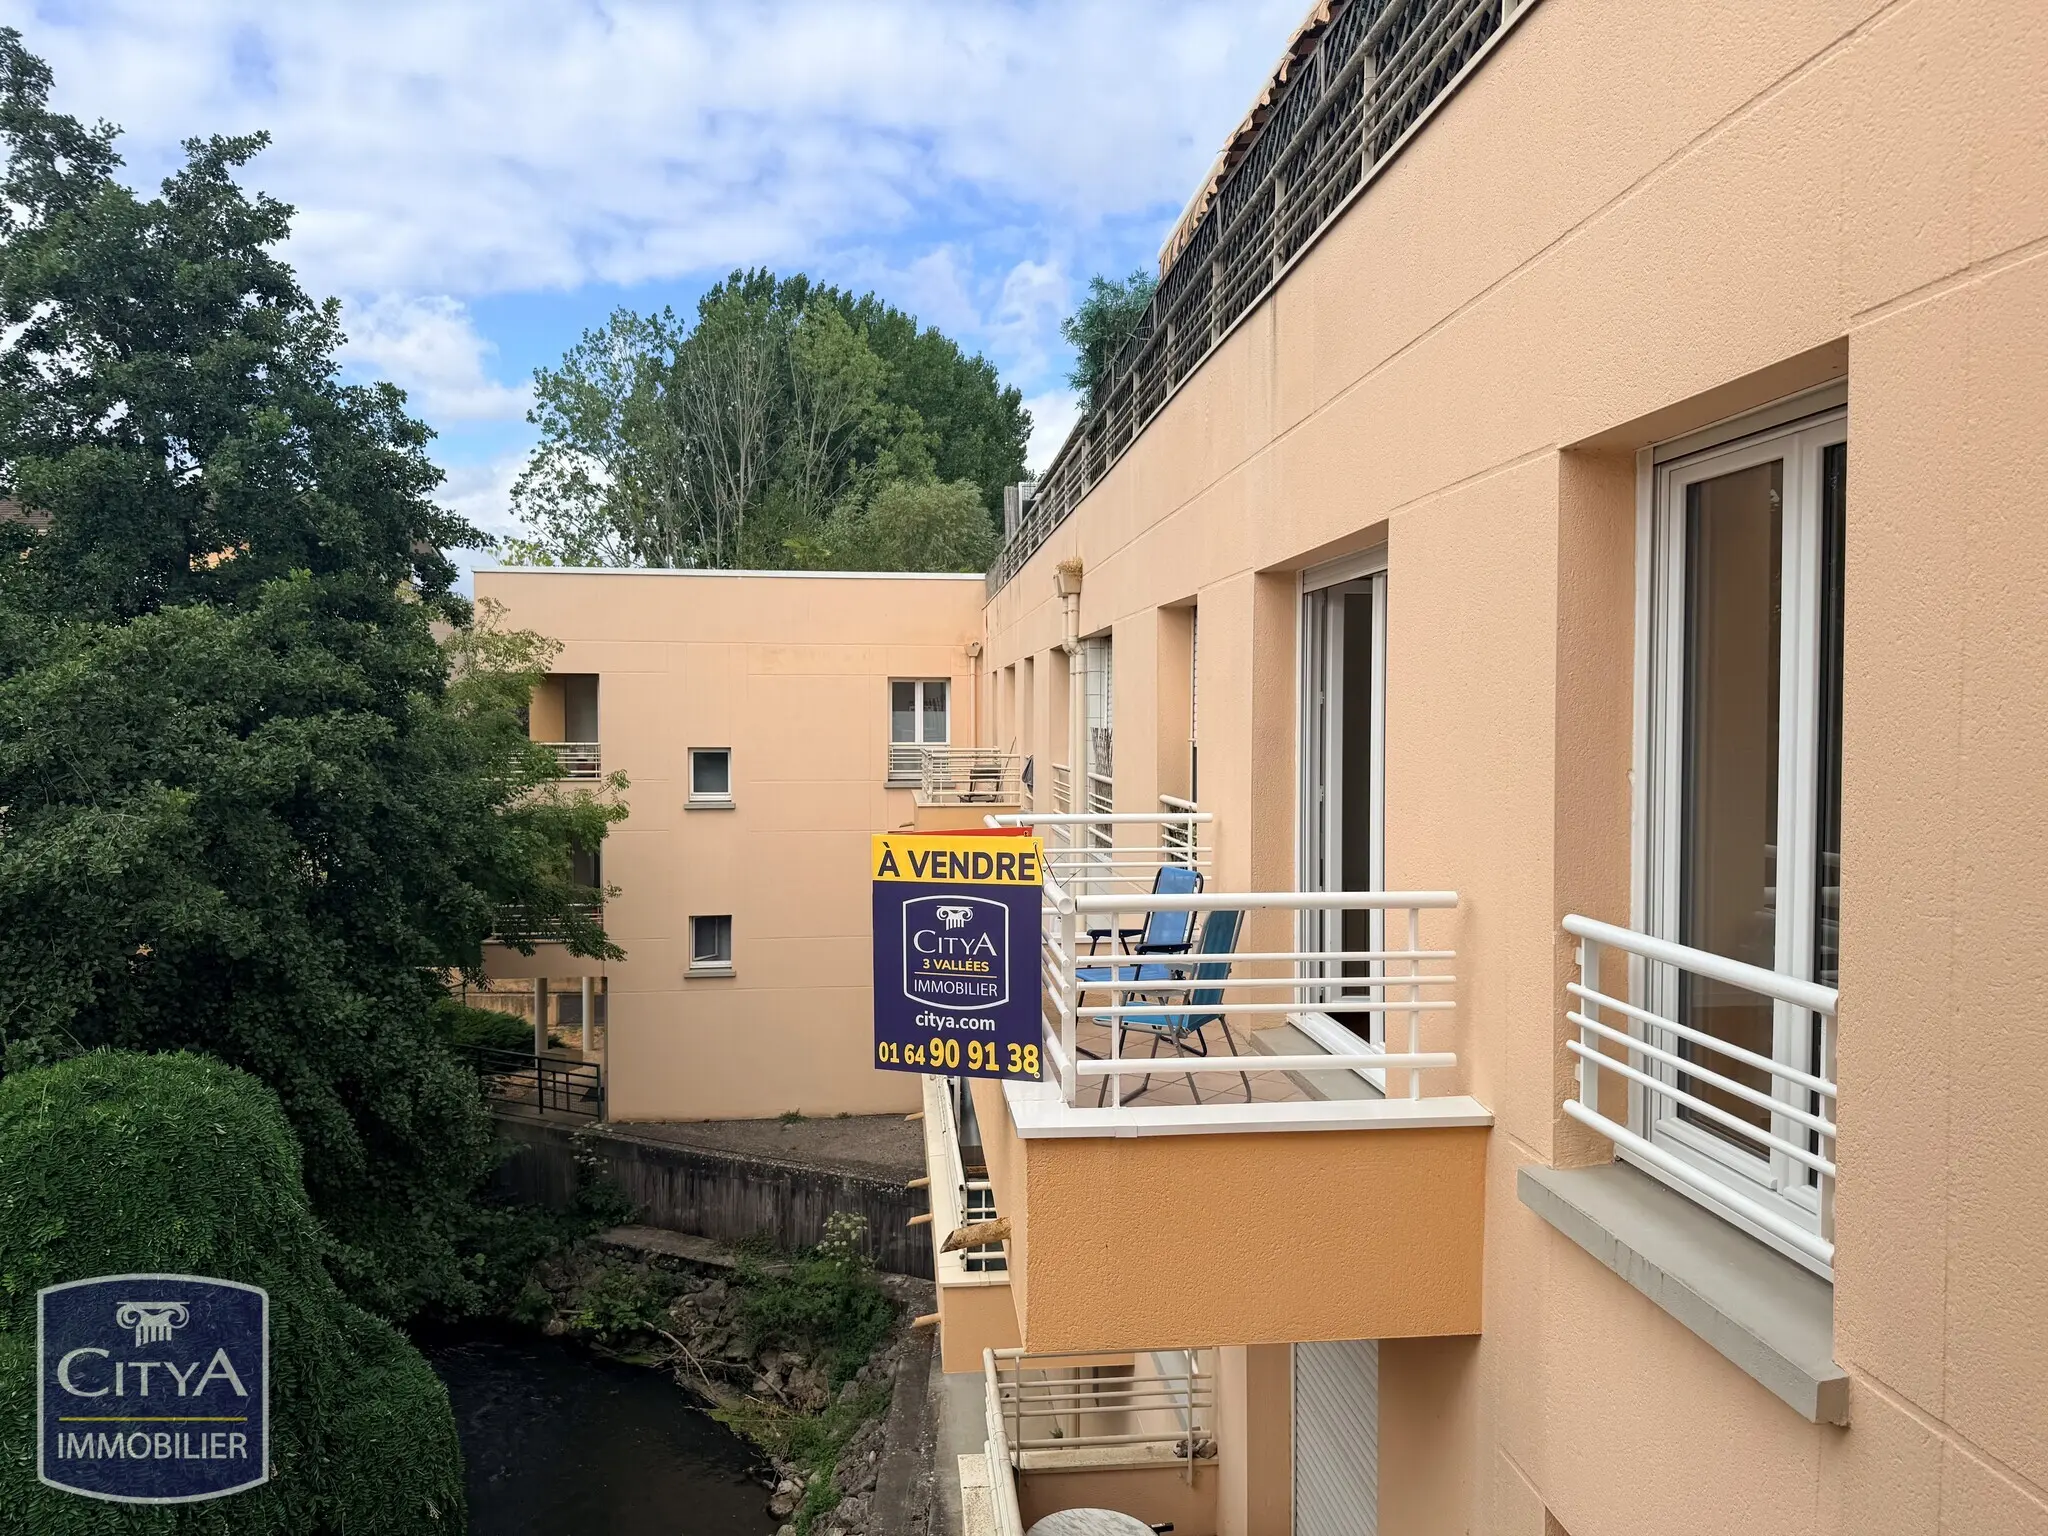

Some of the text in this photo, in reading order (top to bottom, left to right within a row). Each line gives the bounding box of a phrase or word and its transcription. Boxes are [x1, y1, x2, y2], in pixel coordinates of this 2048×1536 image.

[877, 841, 1036, 881] À VENDRE
[922, 958, 990, 972] 3 VALLÉES
[914, 979, 998, 997] IMMOBILIER
[915, 1011, 996, 1031] citya.com
[878, 1037, 1039, 1074] 01 64 90 91 38
